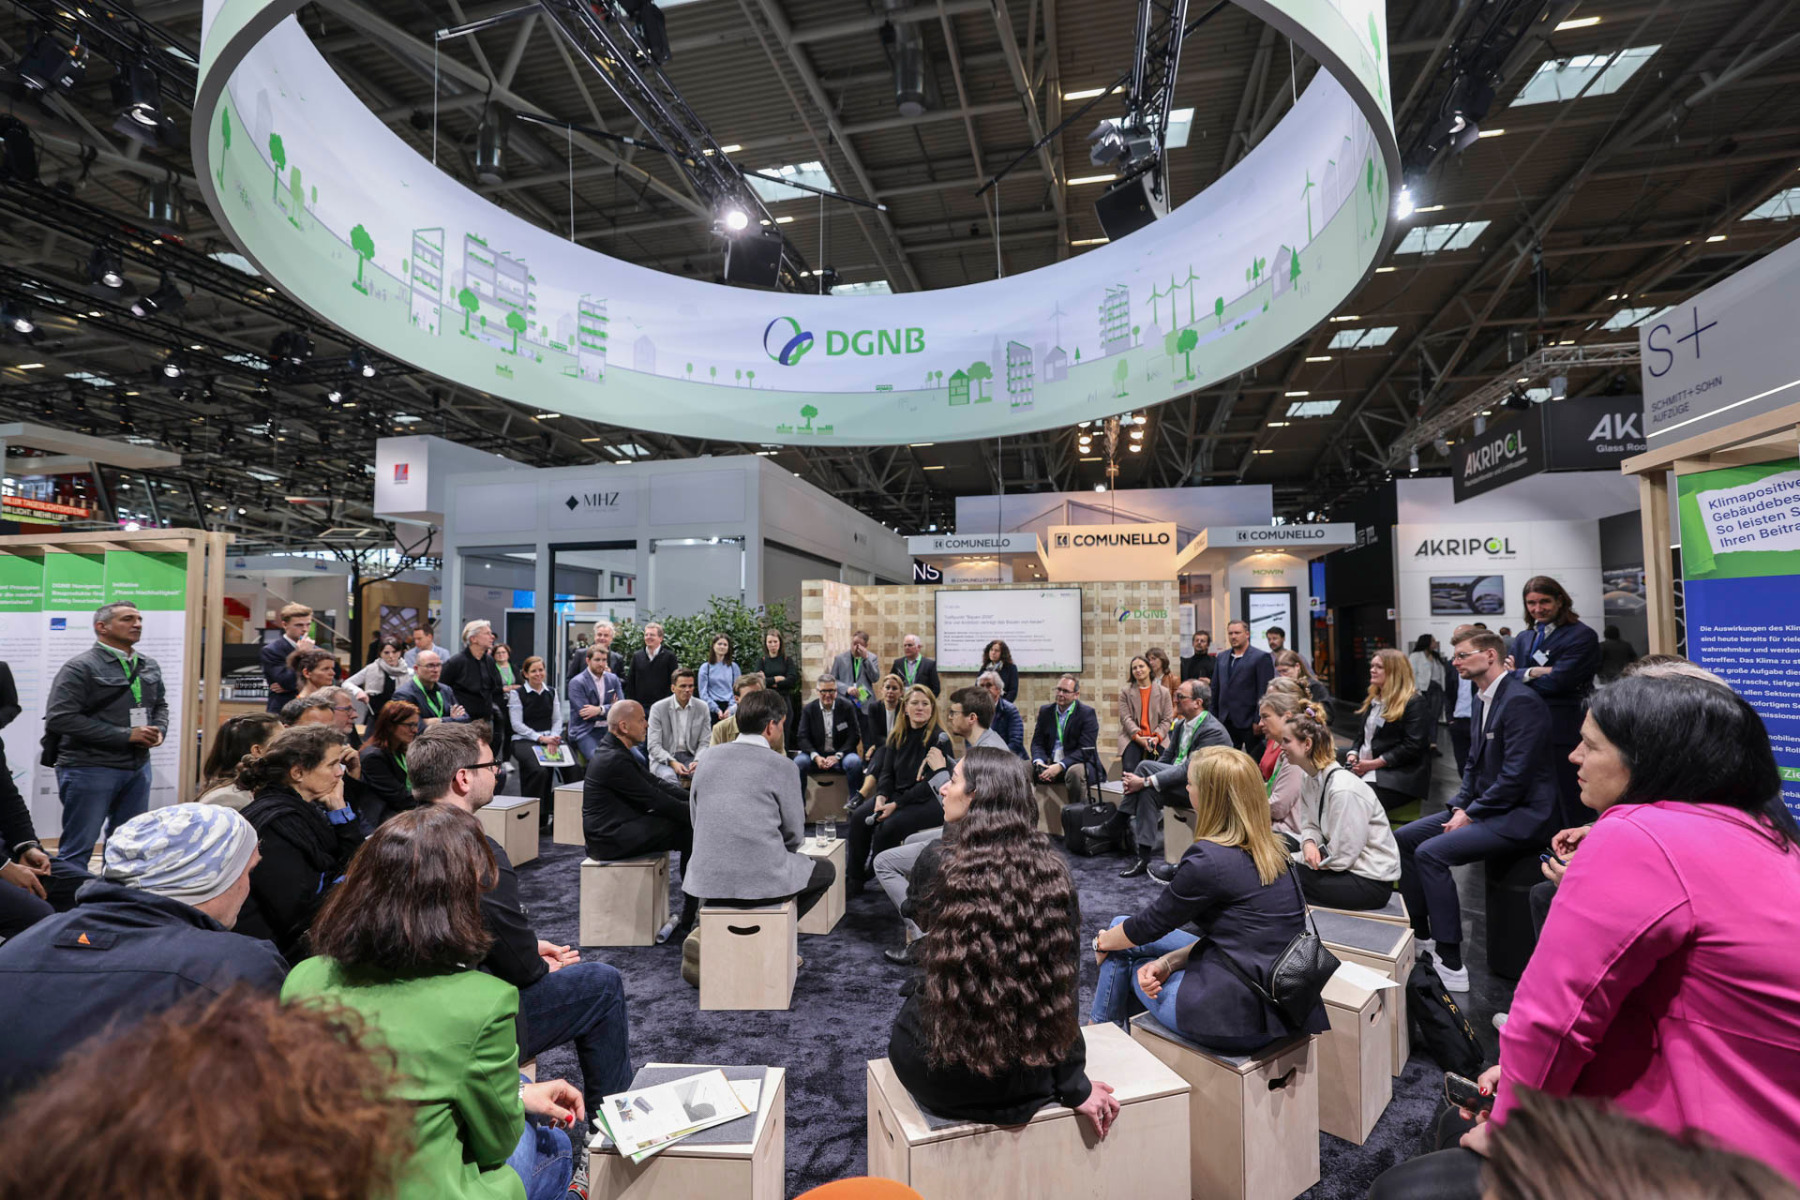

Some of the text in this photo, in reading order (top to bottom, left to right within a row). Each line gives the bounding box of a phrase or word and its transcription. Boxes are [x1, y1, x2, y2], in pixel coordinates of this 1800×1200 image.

[826, 327, 925, 356] DGNB
[1464, 429, 1527, 478] AKRIPOL
[1596, 443, 1624, 453] Glass
[584, 492, 619, 507] MHZ
[1716, 524, 1734, 535] So
[1737, 511, 1786, 530] leisten
[1073, 532, 1170, 547] COMUNELLO
[1250, 529, 1325, 541] COMUNELLO
[1720, 533, 1755, 548] Ihren
[945, 538, 1010, 548] COMUNELLO
[1415, 537, 1516, 557] AKRIPOL
[1134, 609, 1168, 619] DGNB
[1713, 625, 1767, 633] Auswirkungen
[1726, 667, 1748, 675] große
[1742, 679, 1771, 687] rasche,
[1749, 701, 1791, 709] sofortigen
[1757, 712, 1800, 720] missionen
